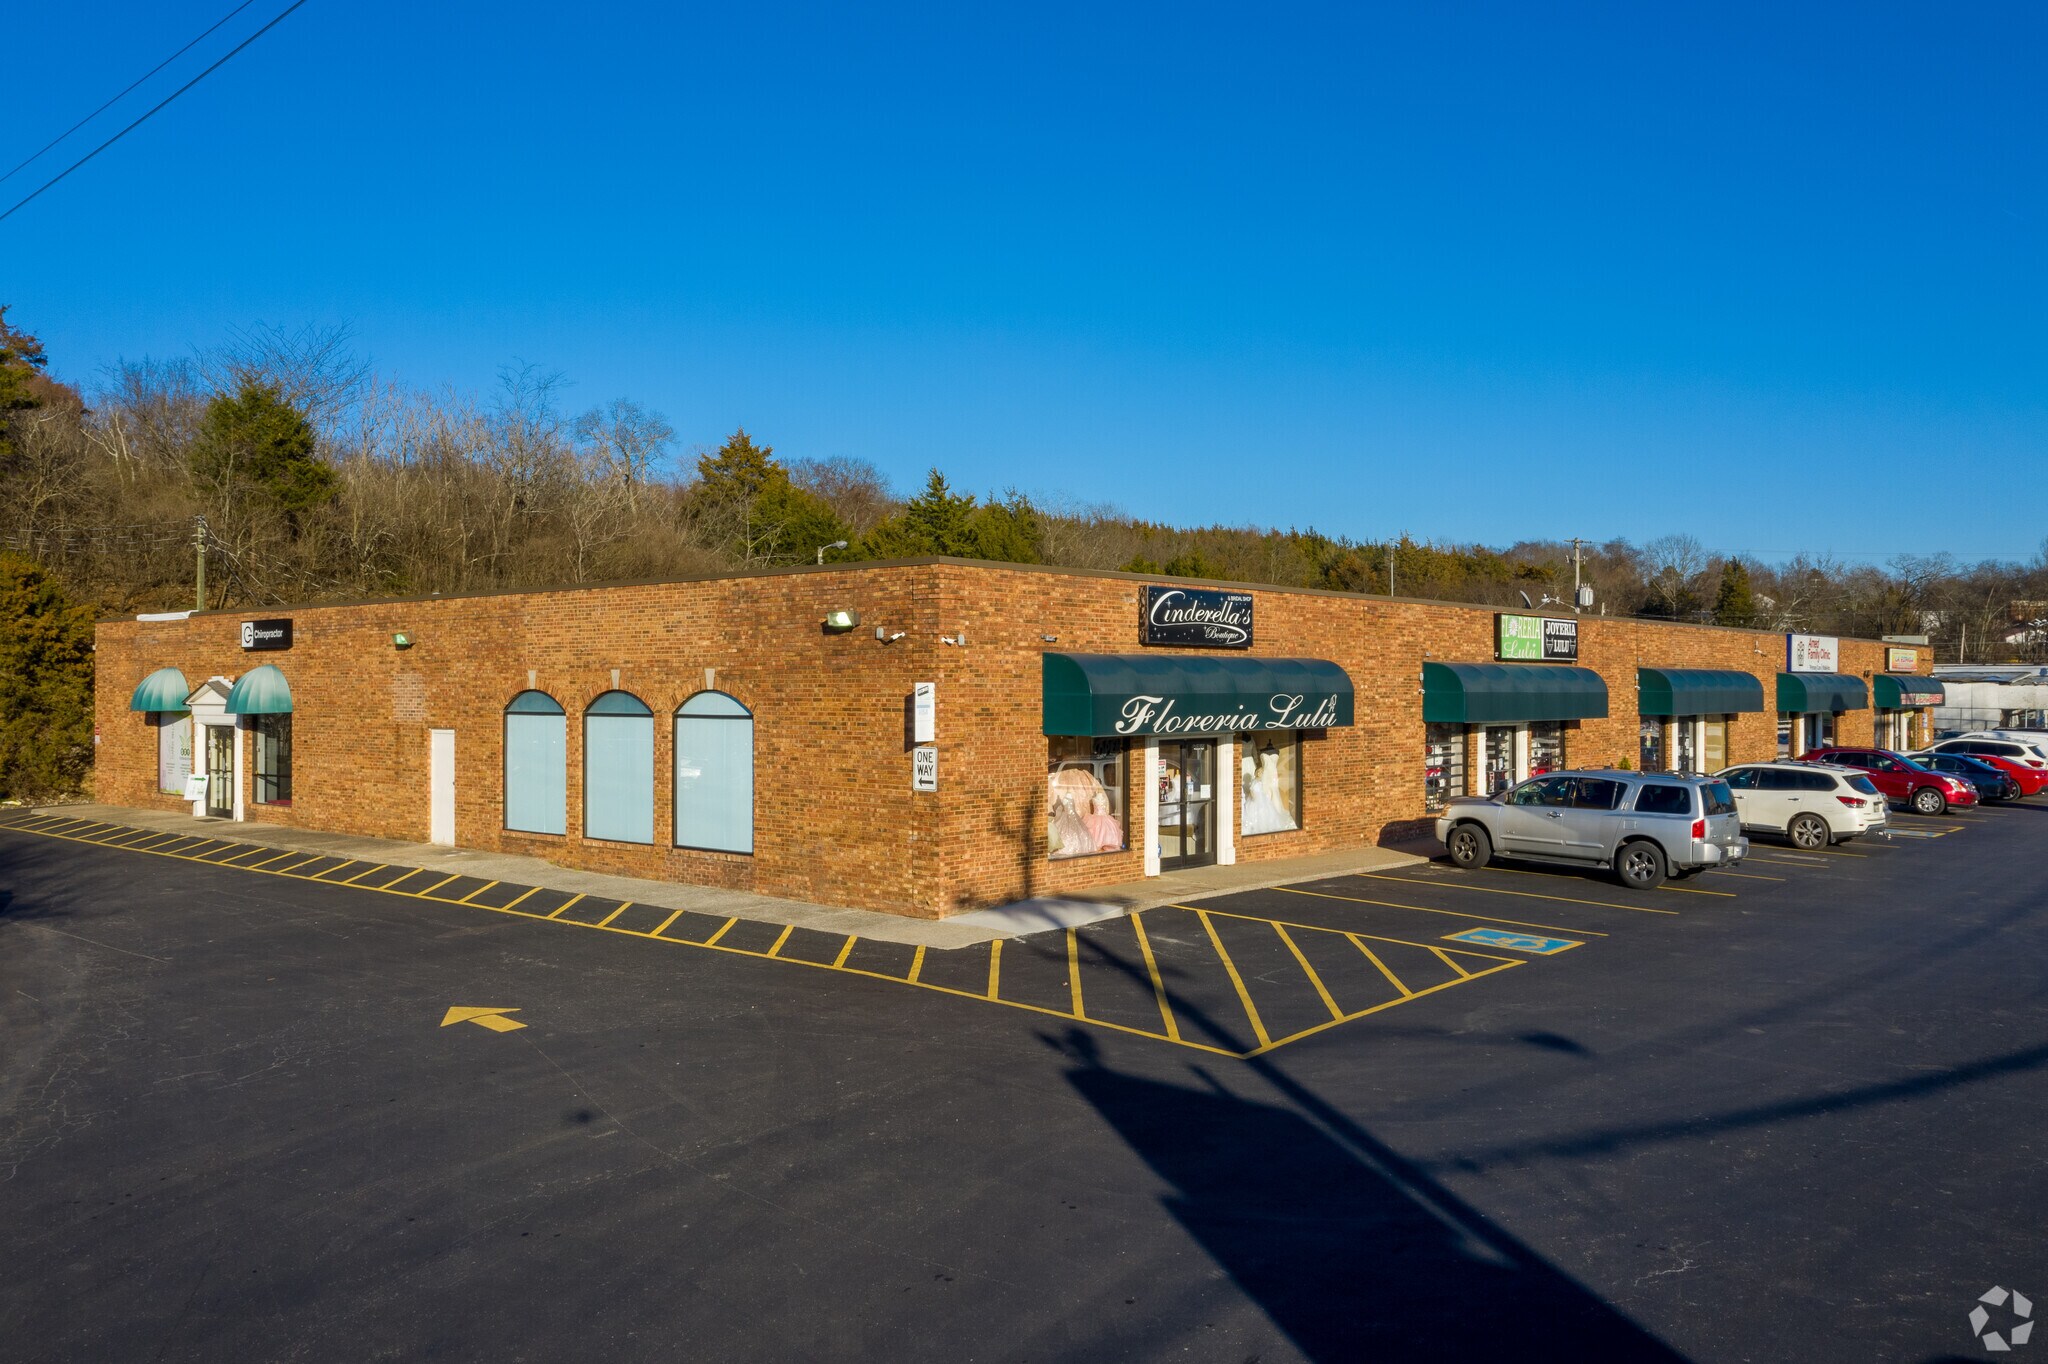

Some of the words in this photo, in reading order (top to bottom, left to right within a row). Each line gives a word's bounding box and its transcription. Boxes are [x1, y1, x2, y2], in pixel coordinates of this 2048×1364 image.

[1150, 590, 1251, 627] Cinderella's
[254, 629, 284, 640] Chiropractor
[1205, 626, 1240, 643] Boutique
[1546, 621, 1576, 636] JOYERIA
[1808, 648, 1820, 663] Family
[1820, 648, 1831, 660] Clinic
[1115, 695, 1260, 734] Floreria
[917, 751, 933, 763] ONE
[917, 764, 934, 776] WAY
